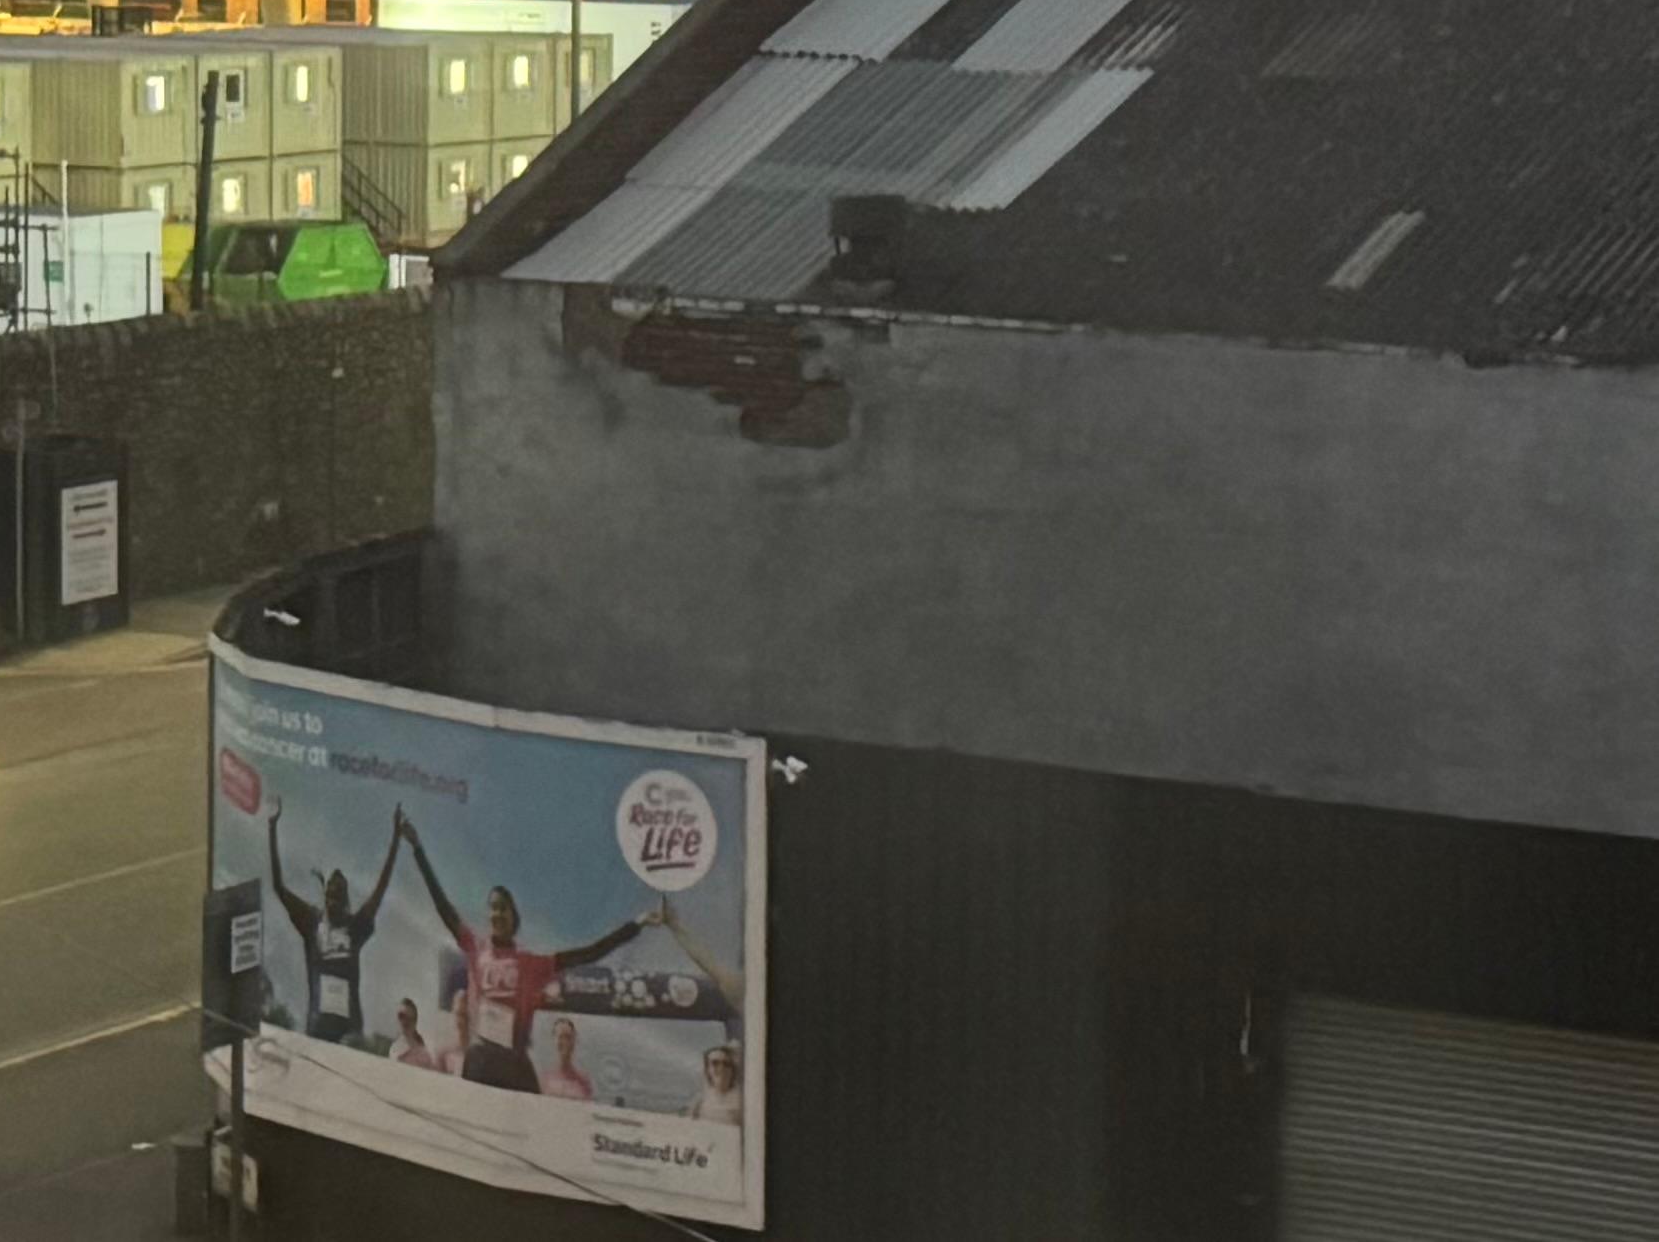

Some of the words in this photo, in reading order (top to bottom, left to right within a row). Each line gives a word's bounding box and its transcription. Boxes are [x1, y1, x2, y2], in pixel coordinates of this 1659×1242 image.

[281, 711, 301, 730] us
[305, 711, 323, 735] to
[308, 745, 328, 768] at
[630, 801, 674, 828] Race
[675, 808, 698, 826] for
[594, 1132, 671, 1163] Standard
[673, 1144, 709, 1168] Life
